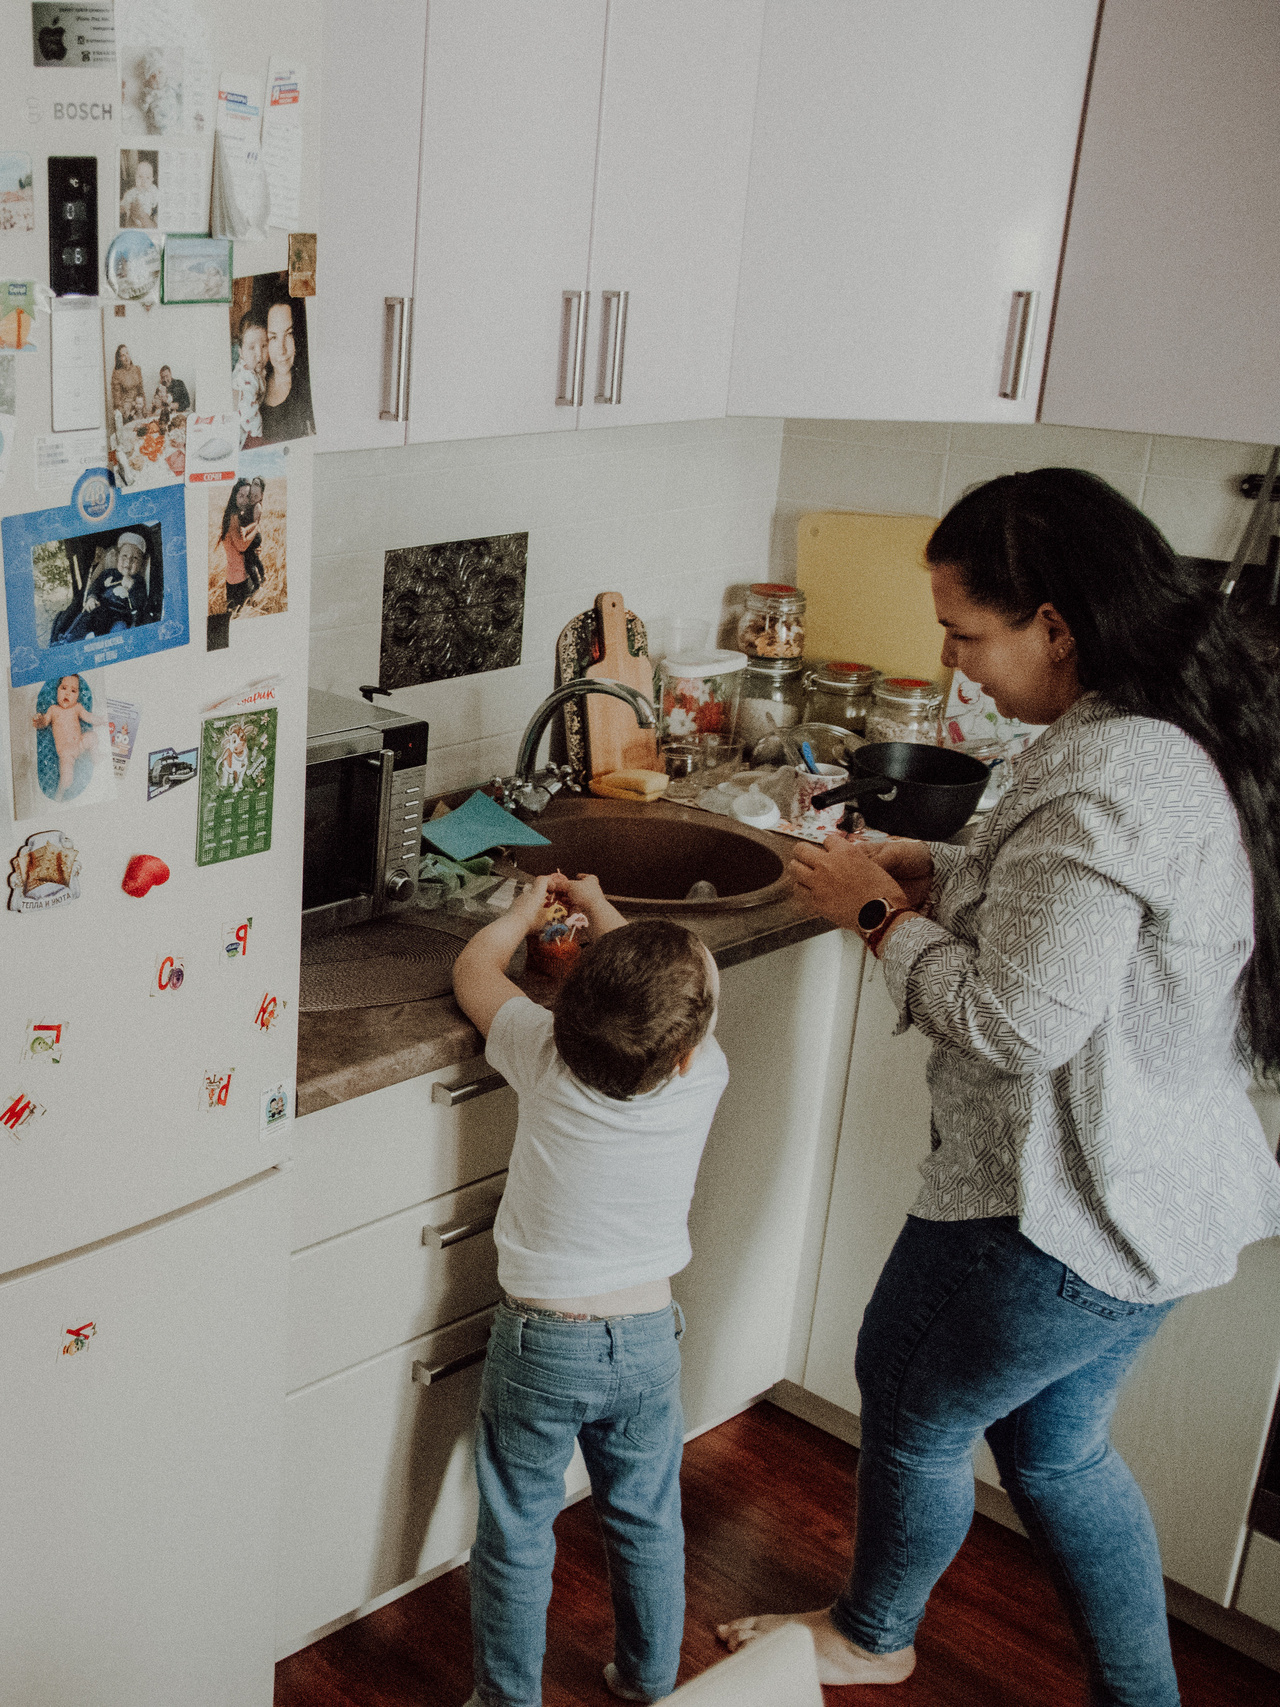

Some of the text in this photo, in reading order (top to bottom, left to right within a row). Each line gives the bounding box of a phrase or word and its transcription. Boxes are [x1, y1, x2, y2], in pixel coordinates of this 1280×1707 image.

[53, 102, 113, 120] BOSCH
[84, 483, 106, 505] 48
[21, 900, 44, 909] ТЕПЛА
[51, 892, 71, 906] УЮТА
